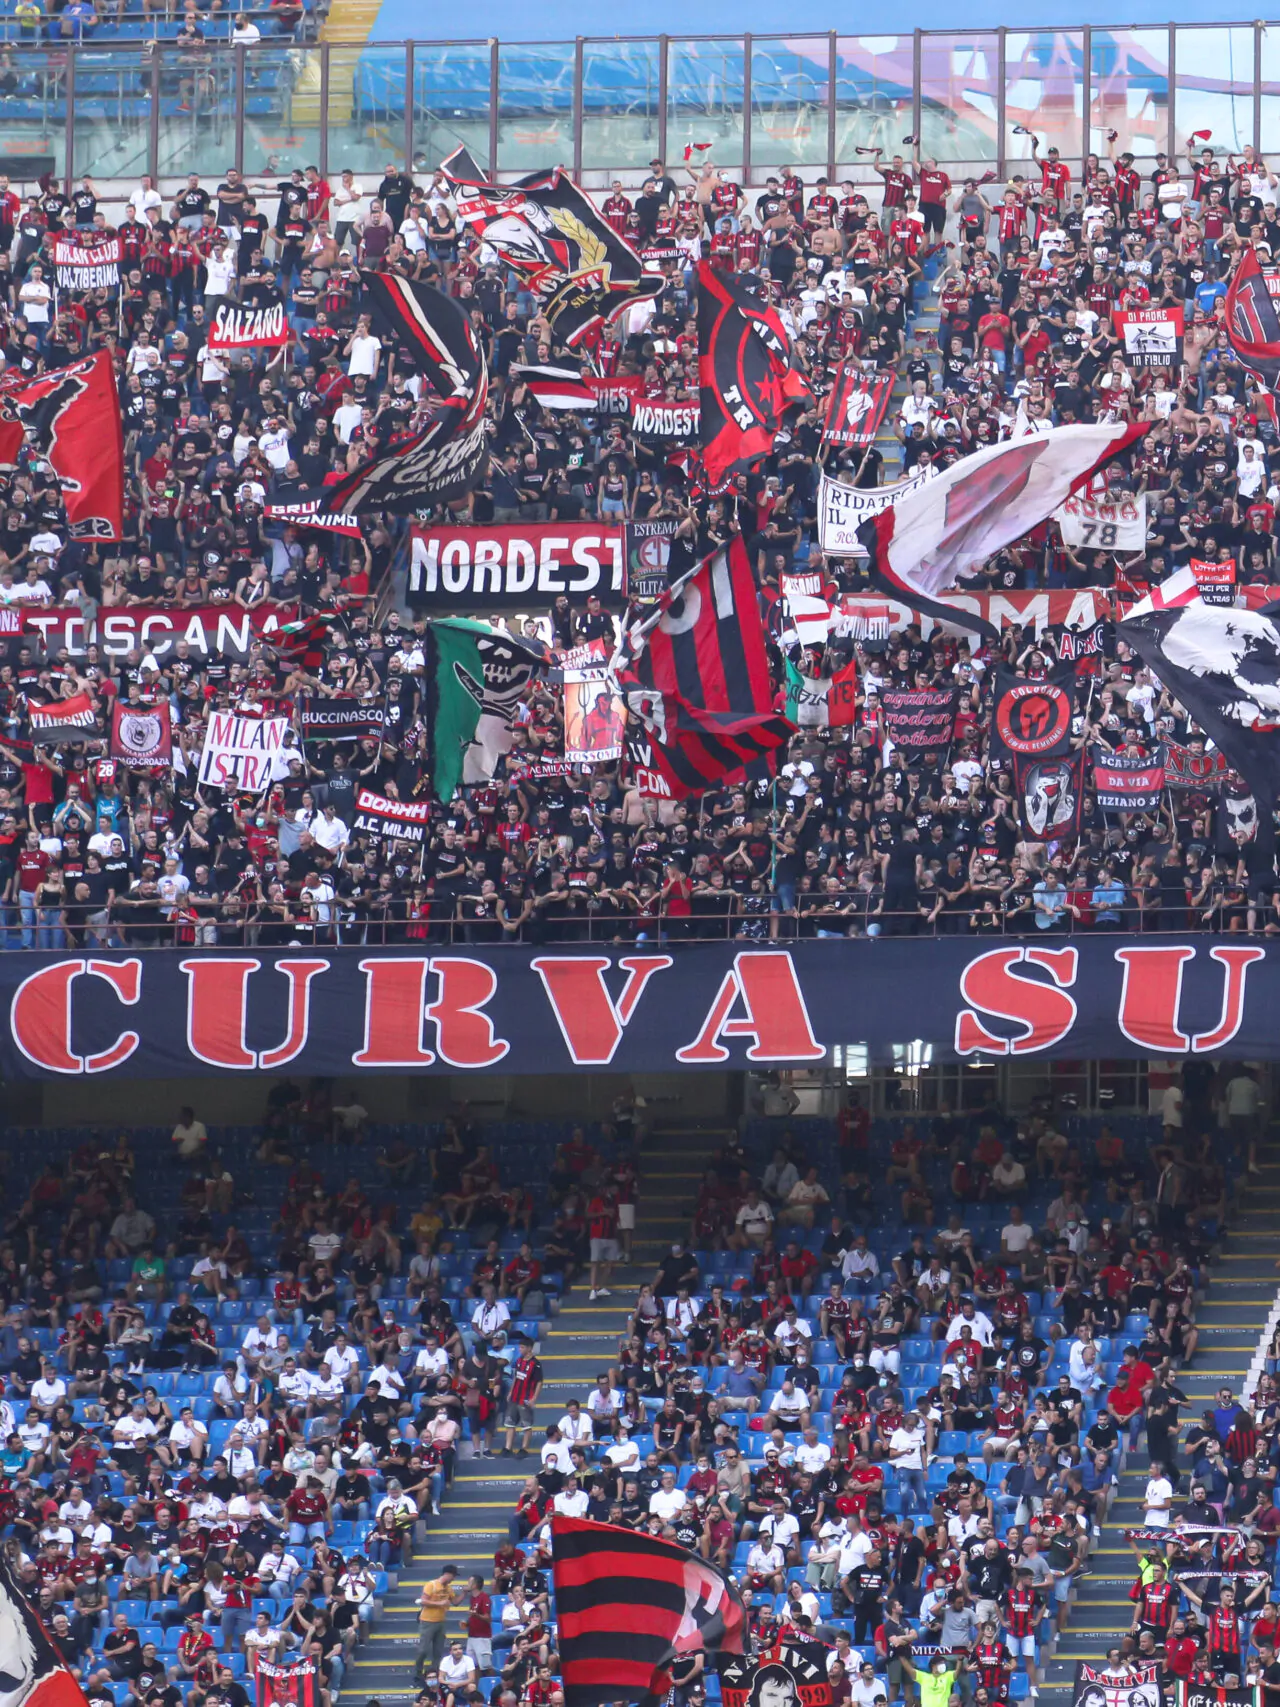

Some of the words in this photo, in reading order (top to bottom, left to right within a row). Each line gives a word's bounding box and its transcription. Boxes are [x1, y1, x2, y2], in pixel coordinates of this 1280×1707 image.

[55, 242, 87, 262] MILAN
[89, 239, 119, 262] CLUB
[57, 263, 119, 288] VALTIBERINA
[213, 302, 284, 343] SALZANO
[1142, 310, 1168, 320] PADRE
[1145, 354, 1171, 366] FIGLIO
[843, 366, 890, 383] GRUPPO
[632, 401, 701, 436] NORDEST
[1063, 497, 1139, 520] ROMA
[1082, 523, 1118, 546] 78
[410, 537, 623, 594] NORDEST
[27, 616, 285, 656] TOSCANA
[885, 690, 953, 710] against
[302, 709, 383, 725] BUCCINASCO
[885, 710, 952, 727] modern
[211, 717, 285, 750] MILAN
[98, 764, 114, 777] 28
[203, 750, 272, 789] ISTRA
[543, 763, 572, 774] MILAN
[1108, 776, 1126, 787] DA
[1129, 776, 1151, 788] VIA
[1097, 795, 1146, 807] TIZIANO
[353, 814, 379, 833] A.C.
[382, 822, 423, 841] MILAN
[10, 950, 827, 1073] CURVA
[911, 1645, 953, 1656] MILAN
[723, 1644, 819, 1684] NATIVI
[1080, 1663, 1158, 1688] NATIVI
